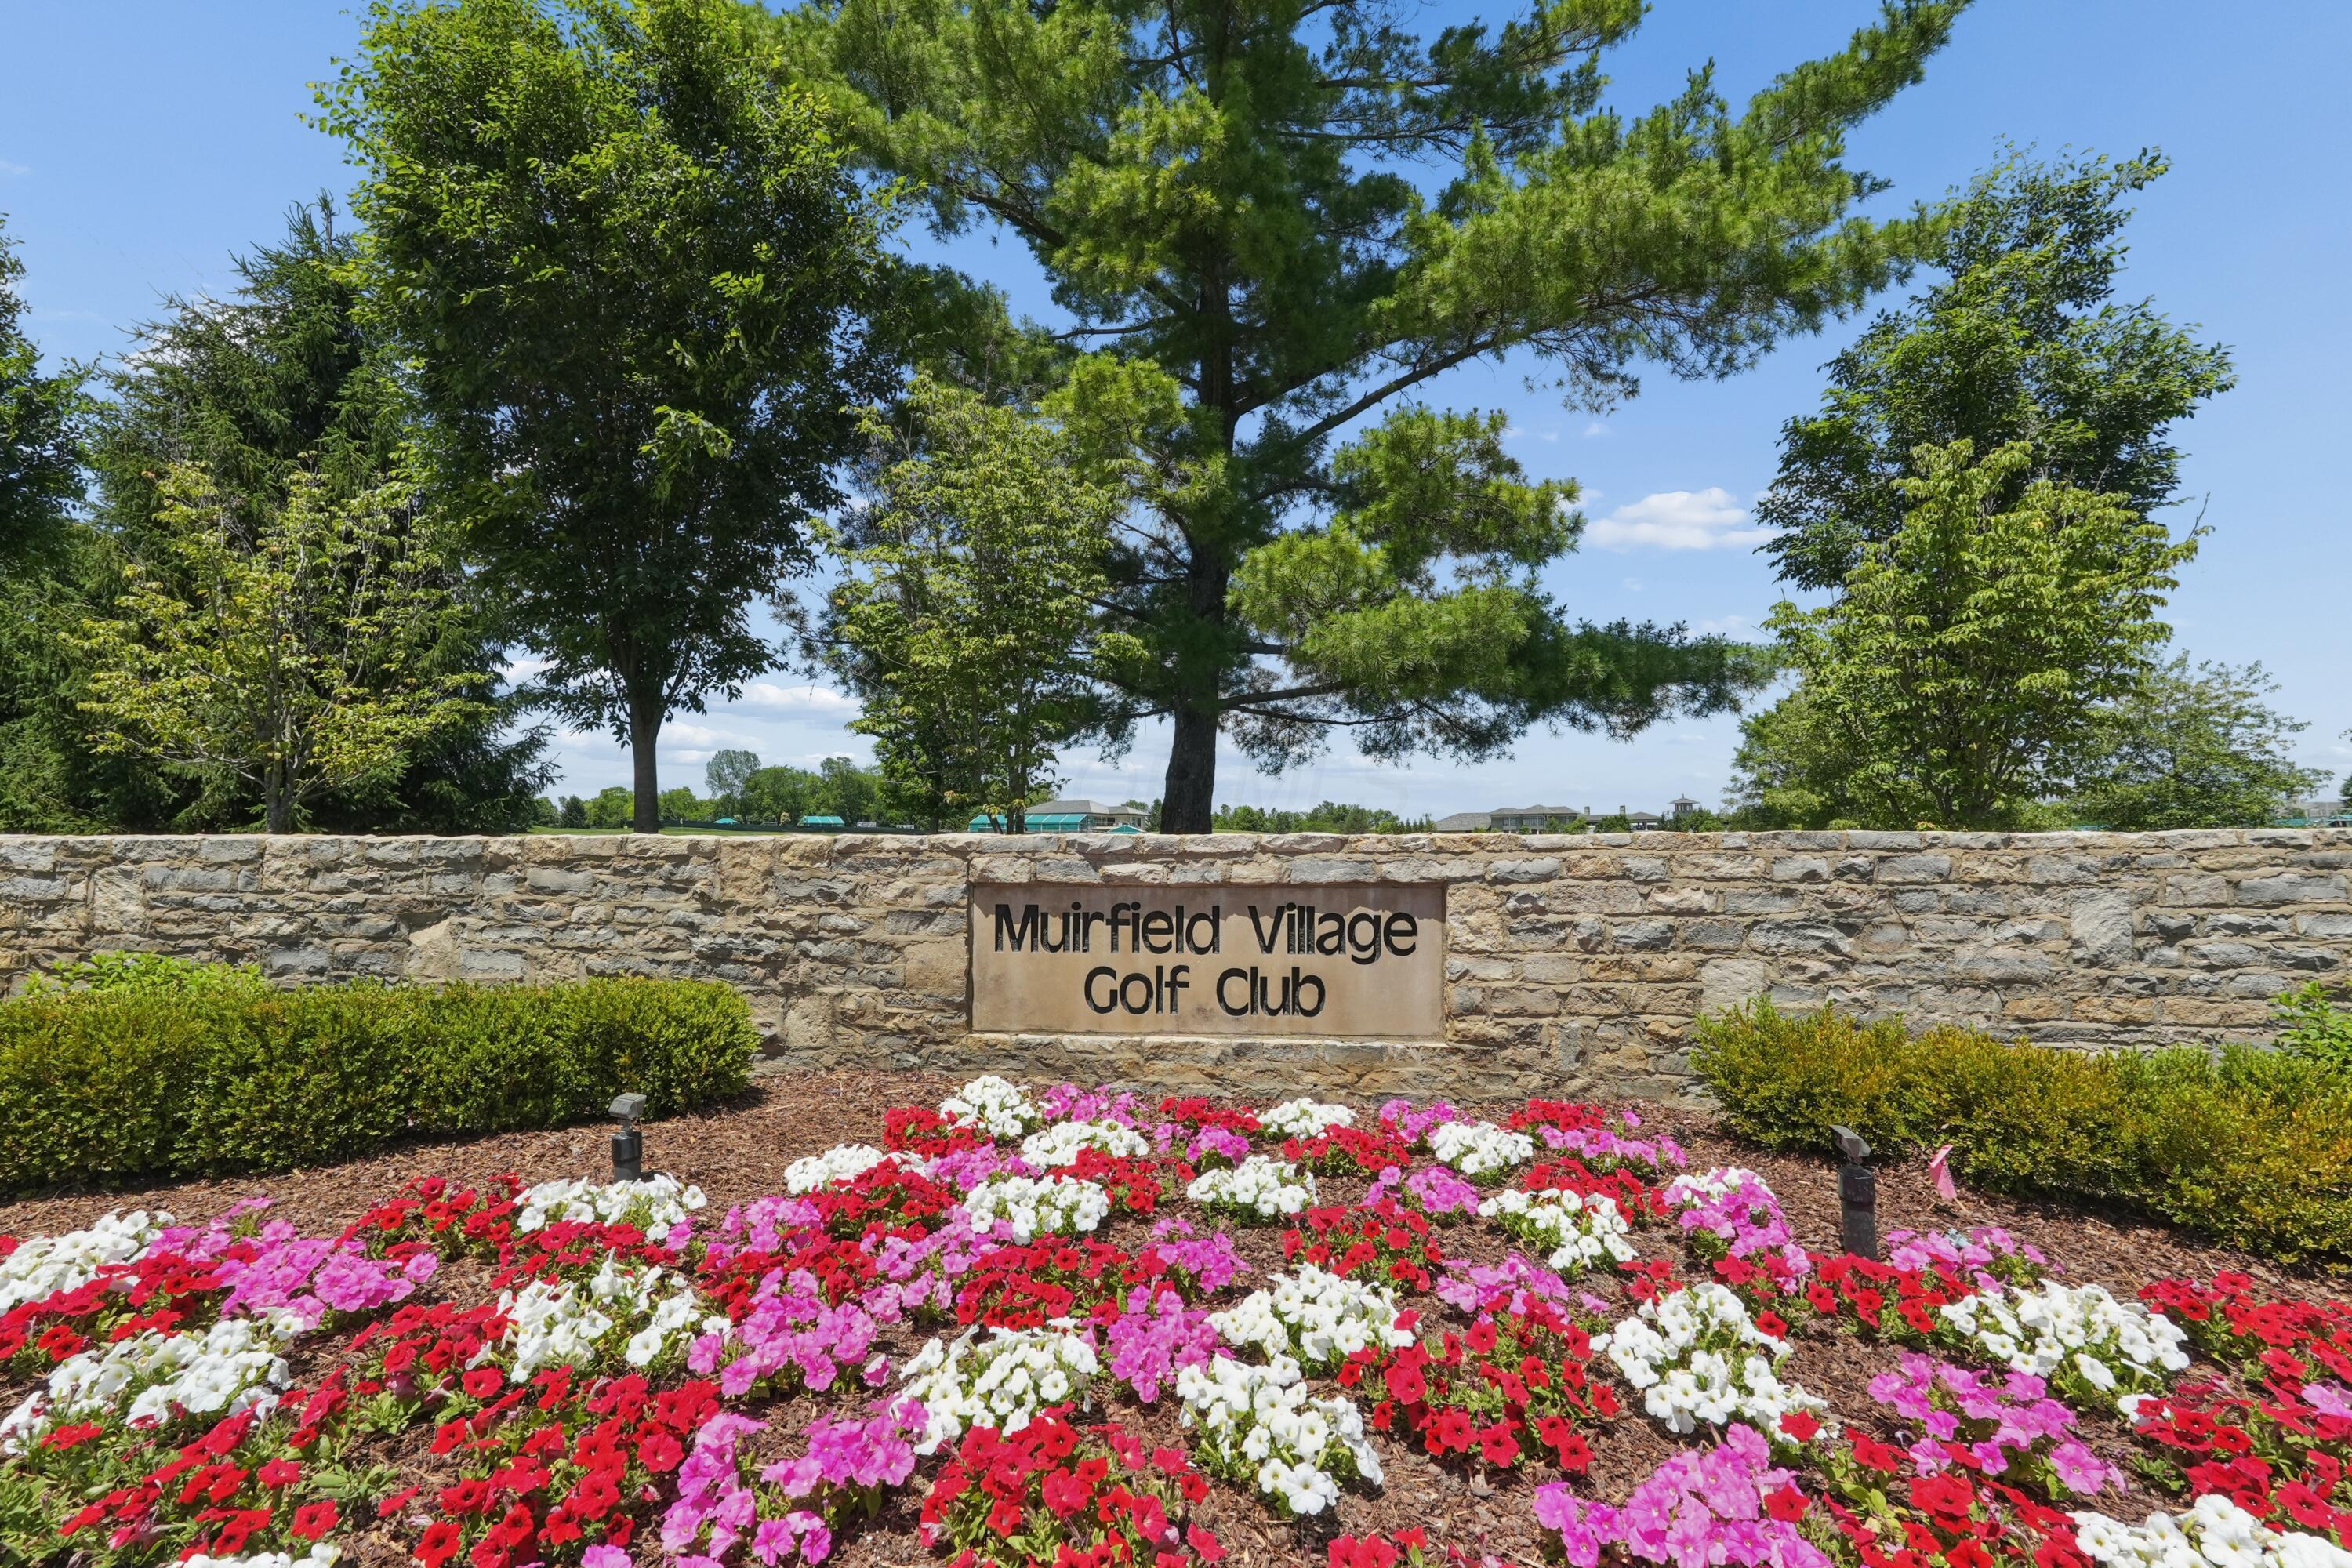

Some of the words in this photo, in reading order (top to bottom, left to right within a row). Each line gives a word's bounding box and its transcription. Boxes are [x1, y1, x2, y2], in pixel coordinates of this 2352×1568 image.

[994, 901, 1221, 956] Muirfield
[1247, 902, 1418, 965] Village
[1084, 964, 1190, 1015] Golf
[1216, 966, 1326, 1018] Club
